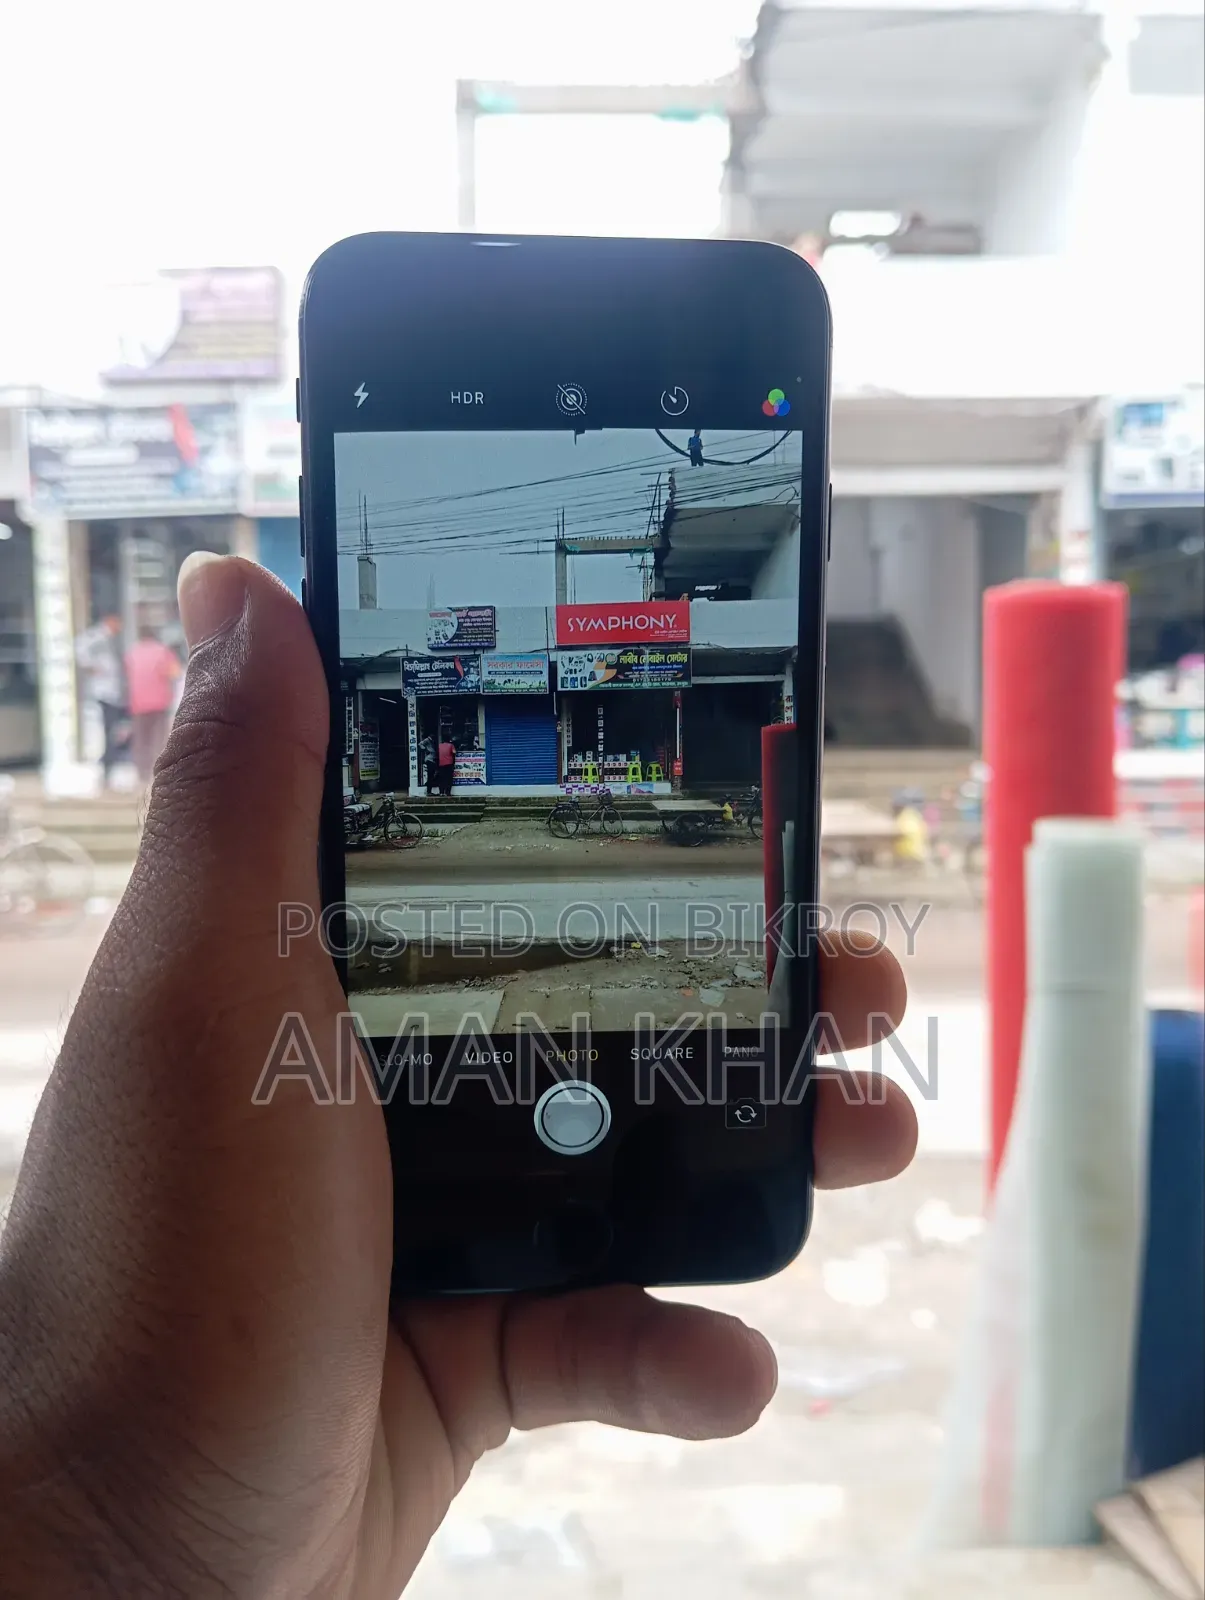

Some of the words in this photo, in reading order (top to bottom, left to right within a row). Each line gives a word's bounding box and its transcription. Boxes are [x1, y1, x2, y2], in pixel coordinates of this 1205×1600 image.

[450, 391, 484, 405] HDR
[567, 613, 677, 633] SYMPHONY
[465, 1050, 513, 1064] VIDEO
[546, 1048, 599, 1062] PHOTO
[630, 1046, 694, 1061] SQUARE
